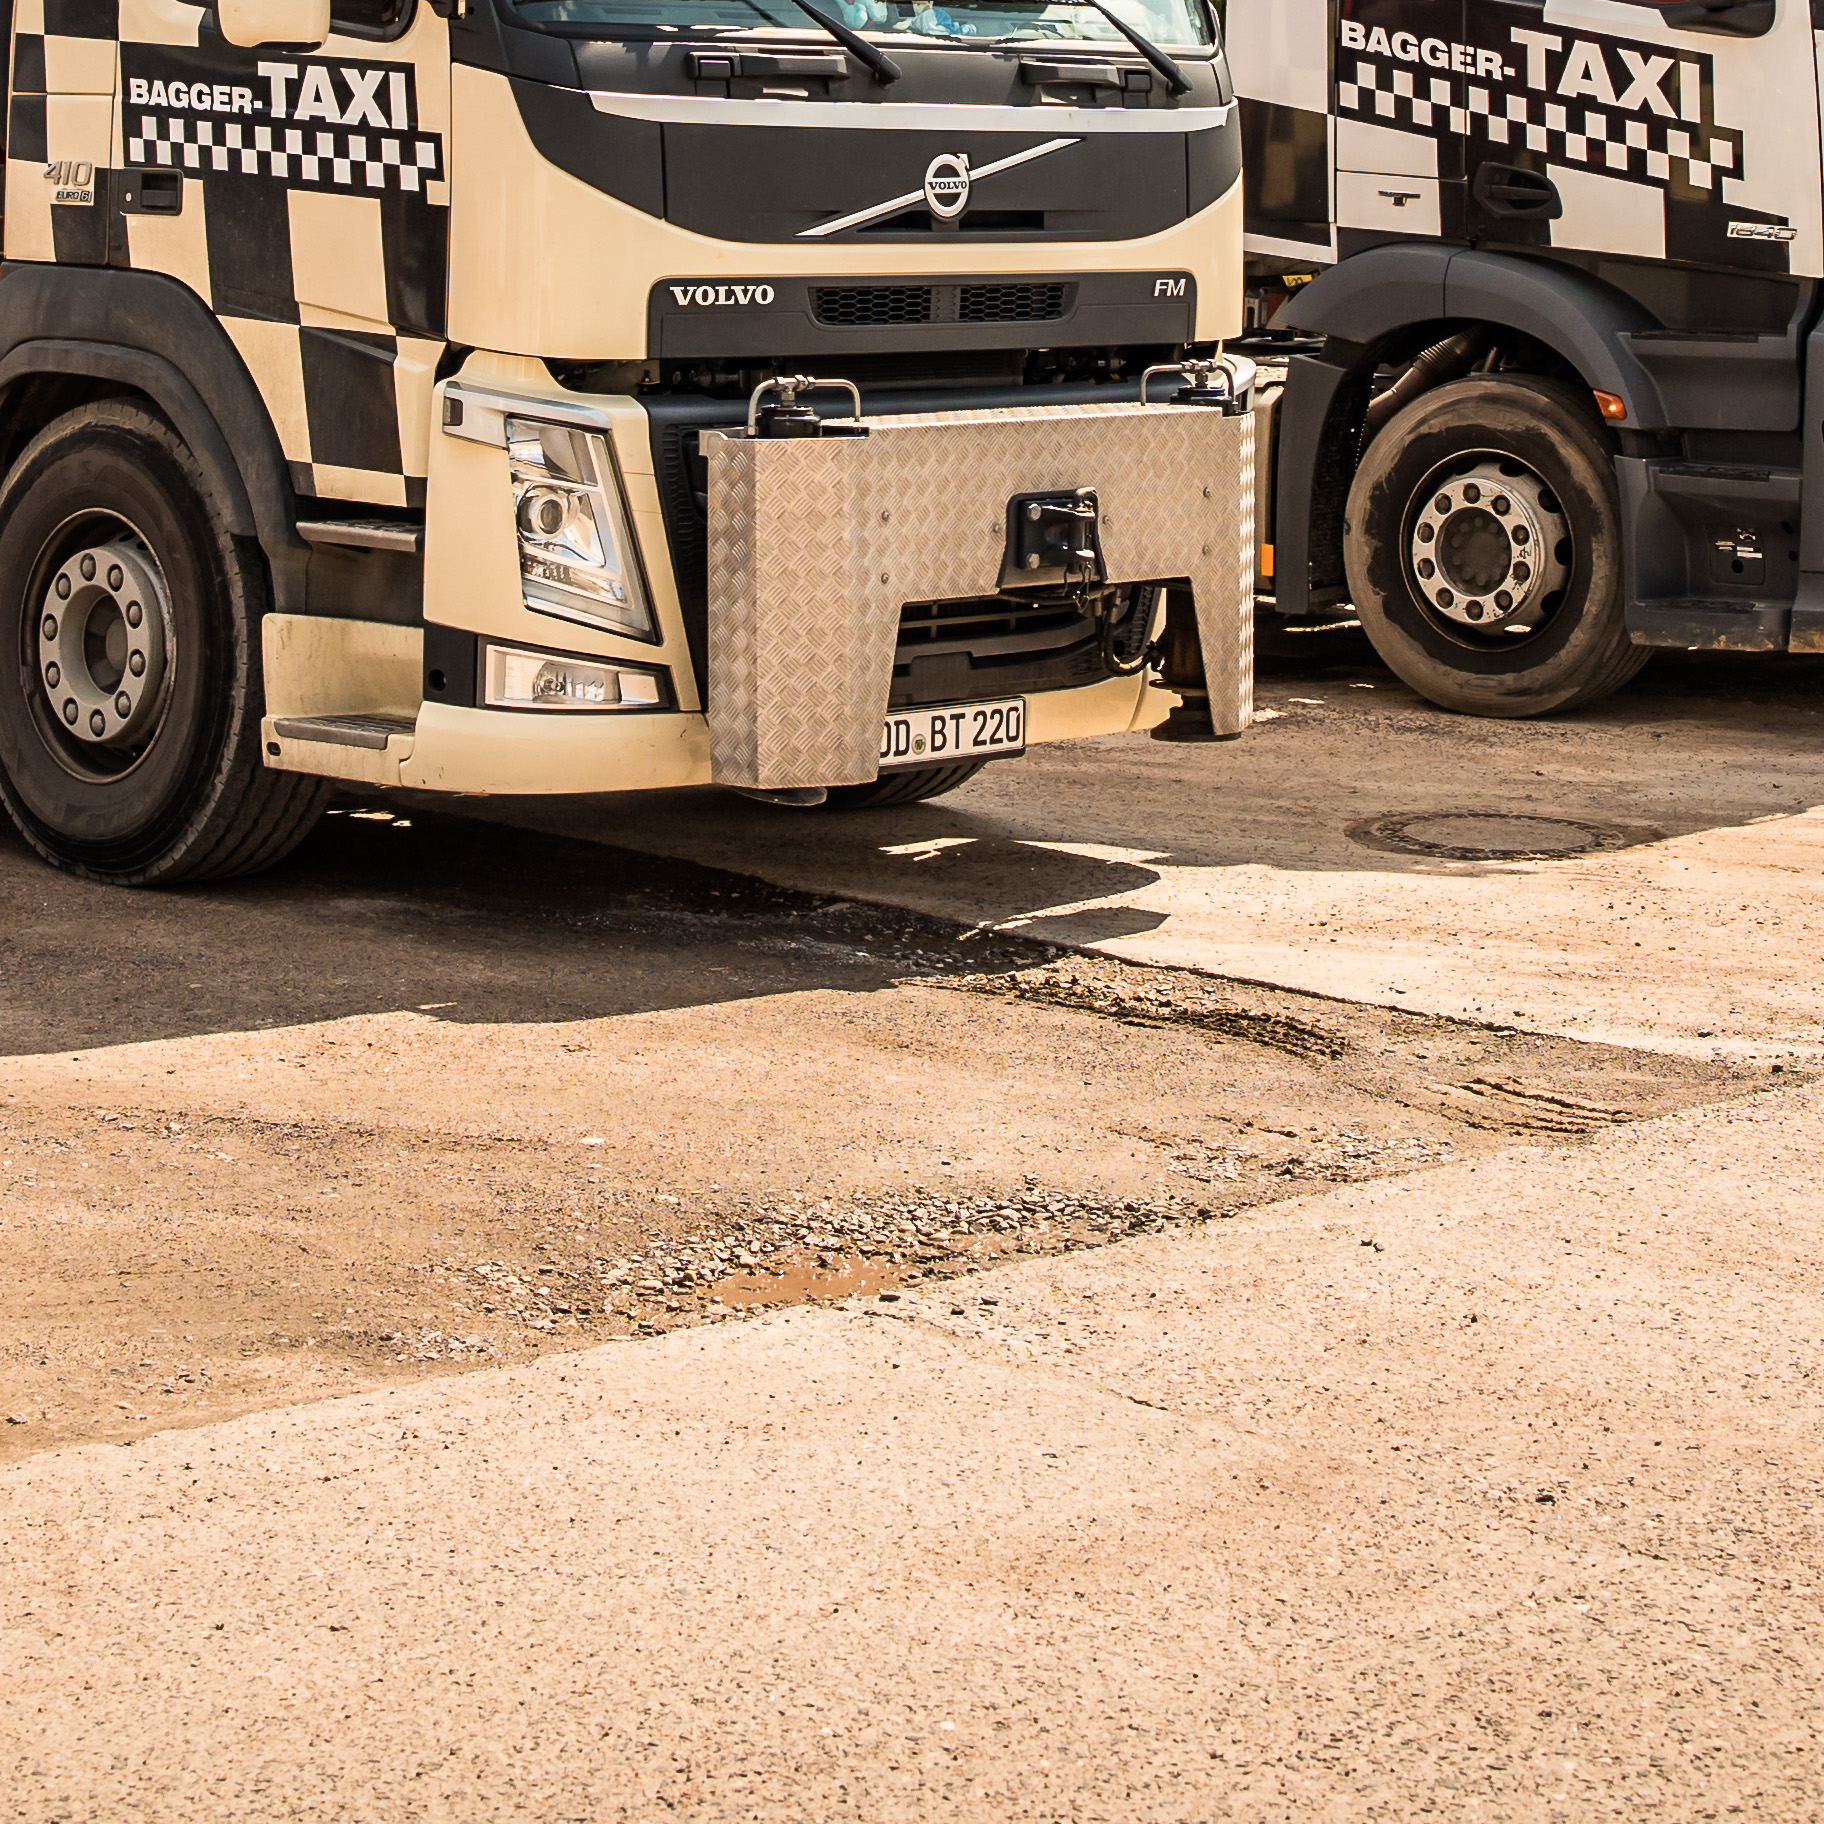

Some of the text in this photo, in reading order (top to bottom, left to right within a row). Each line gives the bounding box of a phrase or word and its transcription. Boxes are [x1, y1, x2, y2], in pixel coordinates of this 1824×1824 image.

[1341, 19, 1701, 124] BAGGER-TAXI
[129, 61, 408, 130] BAGGER-TAXI
[43, 160, 93, 186] 410
[927, 180, 968, 191] VOLVO
[670, 285, 775, 307] VOLVO
[1153, 279, 1187, 298] FM
[931, 712, 966, 753] BT
[972, 706, 1021, 748] 220
